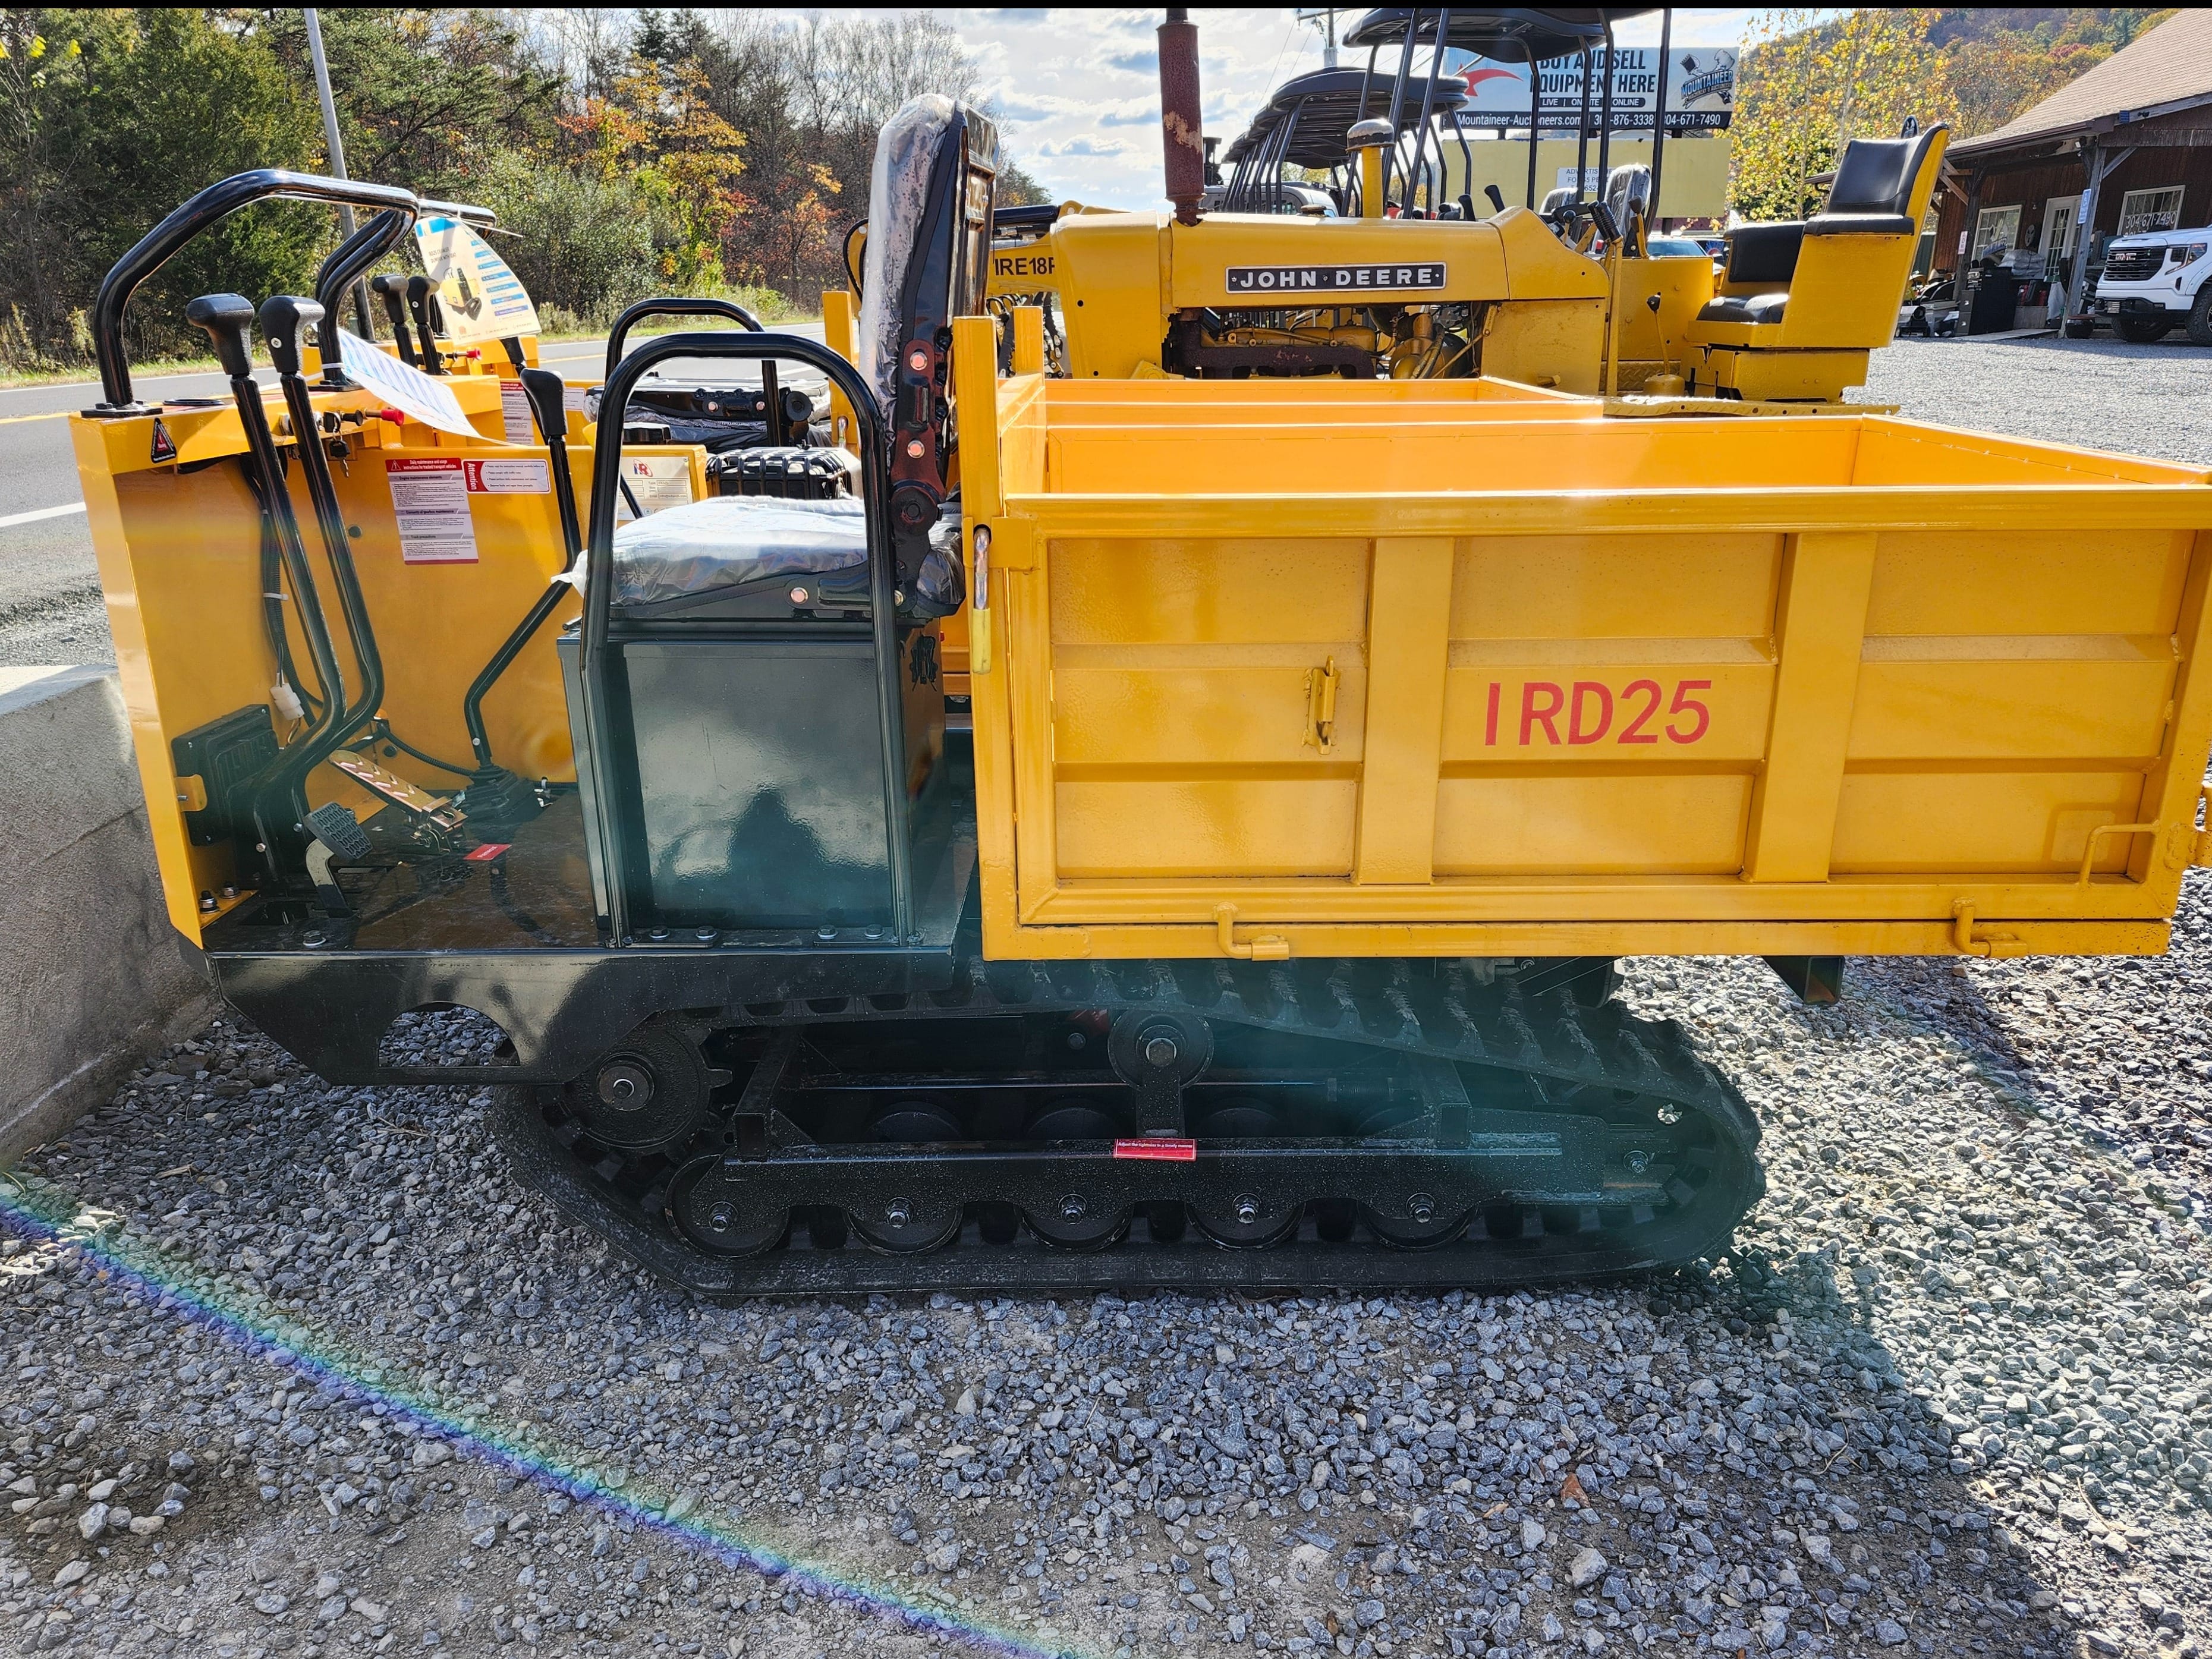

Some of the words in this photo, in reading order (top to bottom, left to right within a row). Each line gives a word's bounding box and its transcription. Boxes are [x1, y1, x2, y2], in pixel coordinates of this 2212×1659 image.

[1613, 50, 1645, 69] SELL
[1618, 74, 1656, 93] HERE
[1681, 71, 1733, 100] MOUNTAINEER
[1612, 98, 1640, 106] ONLINE
[1457, 114, 1582, 127] Mountaineer-Auctneers.com
[1594, 114, 1654, 125] 30-876-3338
[1664, 114, 1721, 125] 04-671-7490
[1240, 271, 1317, 288] JOHN
[1336, 268, 1432, 286] DEERE
[467, 463, 478, 490] Attention
[1484, 679, 1712, 746] IRD25
